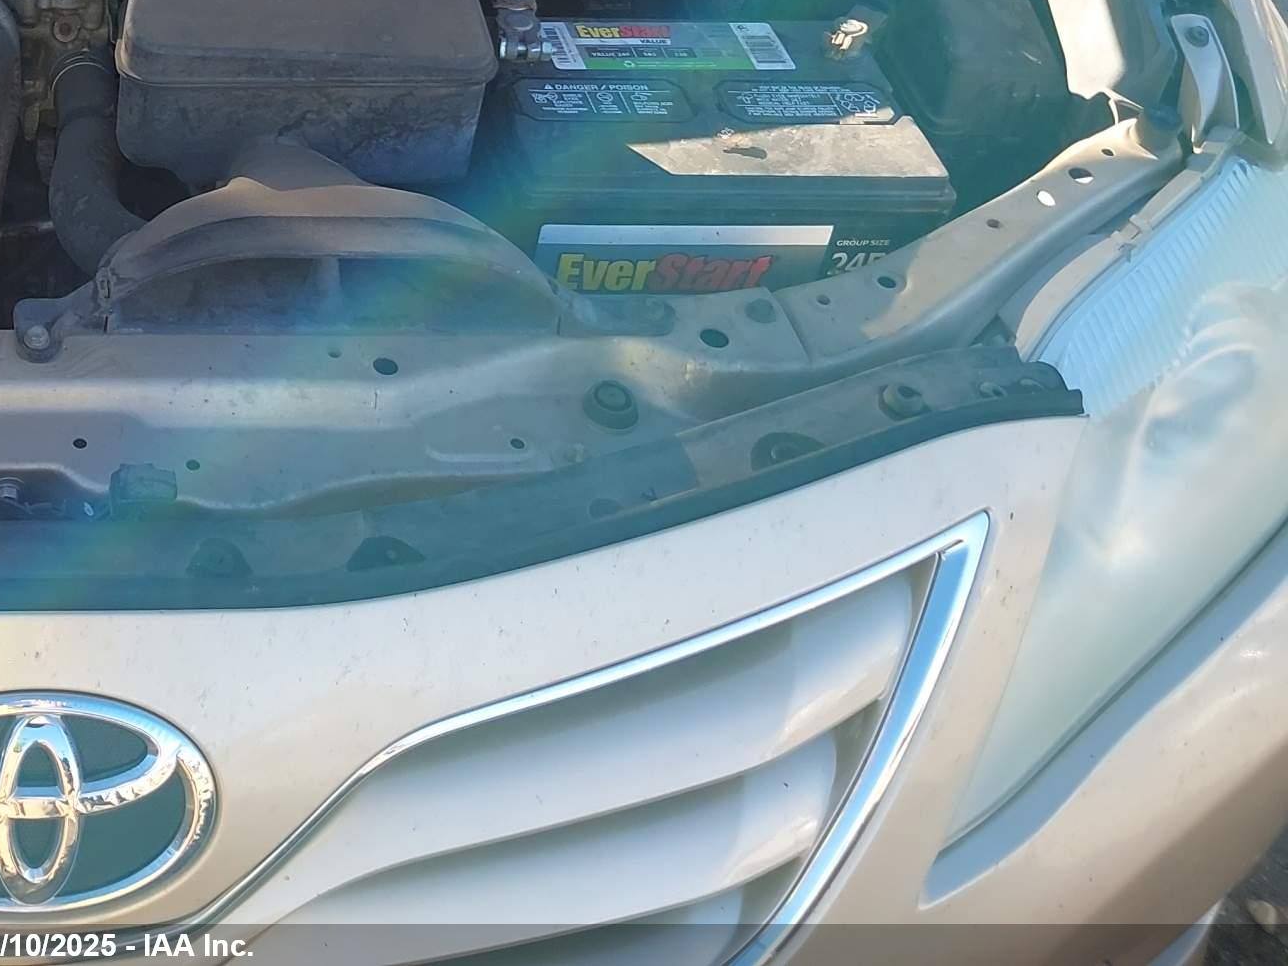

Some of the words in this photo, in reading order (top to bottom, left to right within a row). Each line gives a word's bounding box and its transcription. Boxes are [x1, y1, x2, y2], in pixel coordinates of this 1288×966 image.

[575, 25, 671, 38] EverStart
[835, 239, 870, 247] GROUP
[870, 239, 891, 247] SIZE
[557, 252, 774, 292] EverStart
